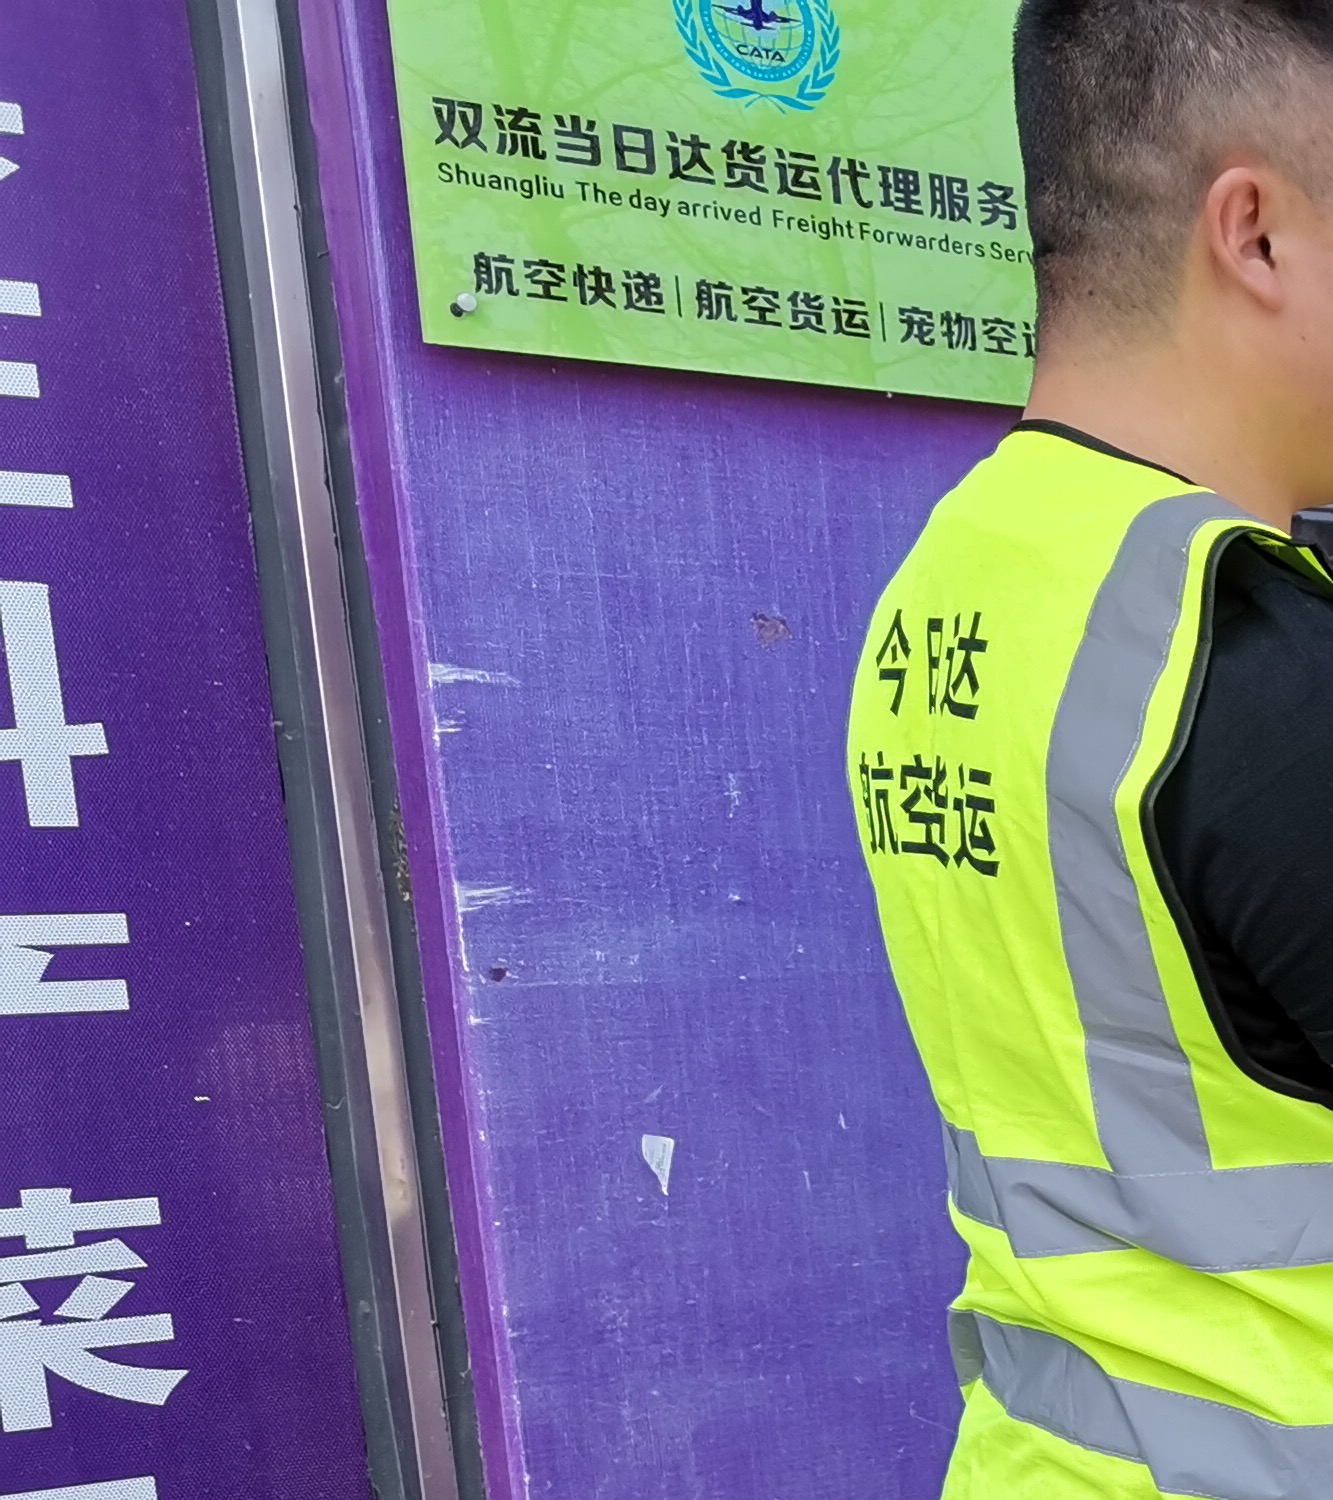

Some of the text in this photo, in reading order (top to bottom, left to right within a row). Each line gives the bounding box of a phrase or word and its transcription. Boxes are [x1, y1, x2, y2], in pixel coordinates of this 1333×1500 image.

[736, 44, 786, 62] CATA
[431, 96, 1019, 231] 双流当日达货运代理服务
[437, 162, 565, 199] Shuangliu
[574, 180, 623, 207] The
[628, 188, 671, 218] day
[677, 199, 762, 227] arrived
[772, 209, 855, 240] Freight
[859, 221, 986, 259] Forwarders
[473, 251, 666, 315] 航空快递
[695, 278, 871, 339] 航空货运
[875, 608, 990, 721] 今日达
